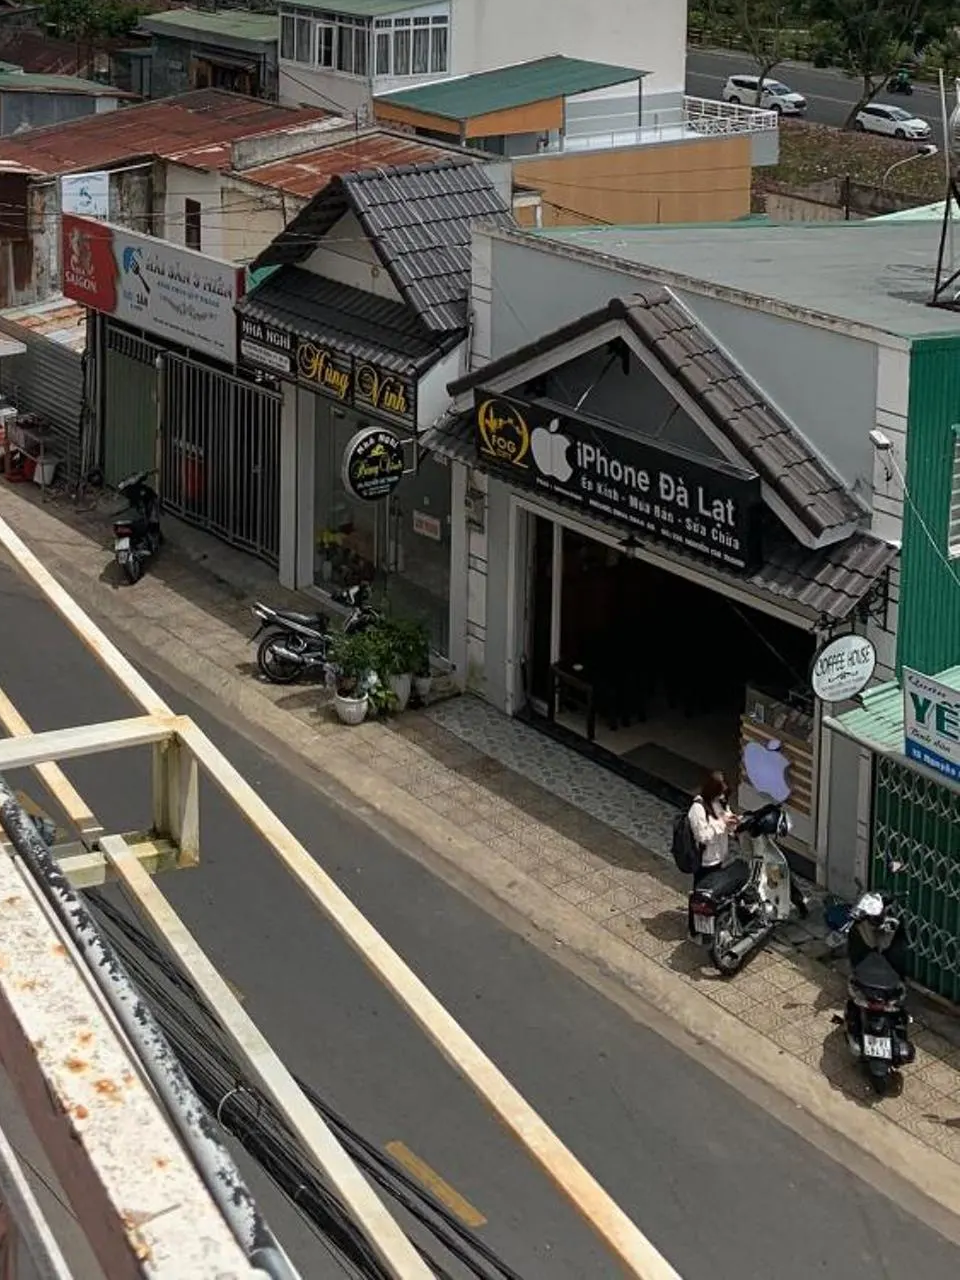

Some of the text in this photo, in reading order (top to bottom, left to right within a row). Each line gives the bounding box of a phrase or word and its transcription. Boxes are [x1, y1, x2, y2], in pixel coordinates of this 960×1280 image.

[577, 441, 650, 492] iPhone
[659, 472, 689, 509] Đà
[698, 486, 736, 529] Lạt
[629, 495, 651, 515] Mua
